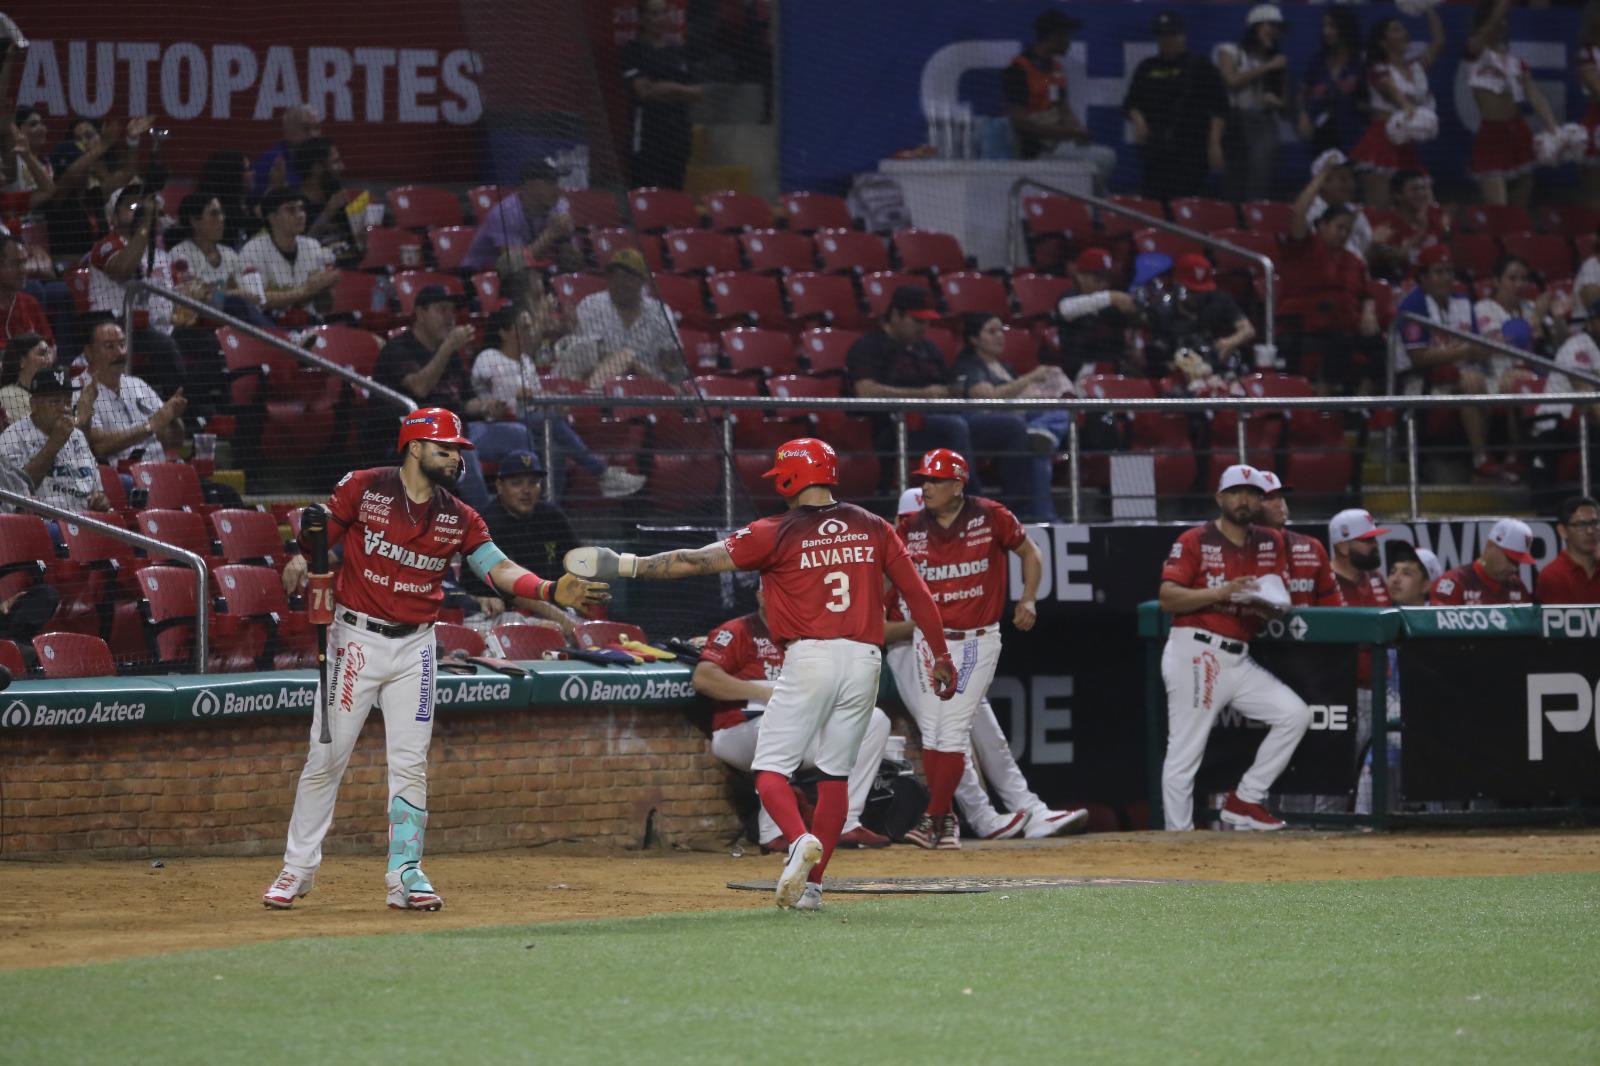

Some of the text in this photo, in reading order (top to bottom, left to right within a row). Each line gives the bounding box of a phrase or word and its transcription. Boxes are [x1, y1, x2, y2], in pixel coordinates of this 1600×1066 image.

[17, 40, 484, 125] AUTOPARTES
[362, 490, 395, 504] telcel
[802, 533, 869, 549] Banco Azteca
[800, 546, 875, 570] ALVAREZ
[364, 569, 390, 586] Red
[823, 571, 851, 612] 3
[1436, 610, 1490, 631] ARCO
[417, 648, 431, 714] PAQUETEXPRESS
[454, 681, 511, 703] Azteca
[590, 679, 696, 701] Banco Azteca
[33, 700, 146, 727] Banco Azteca
[223, 691, 274, 714] Banco
[1526, 672, 1600, 761] P
